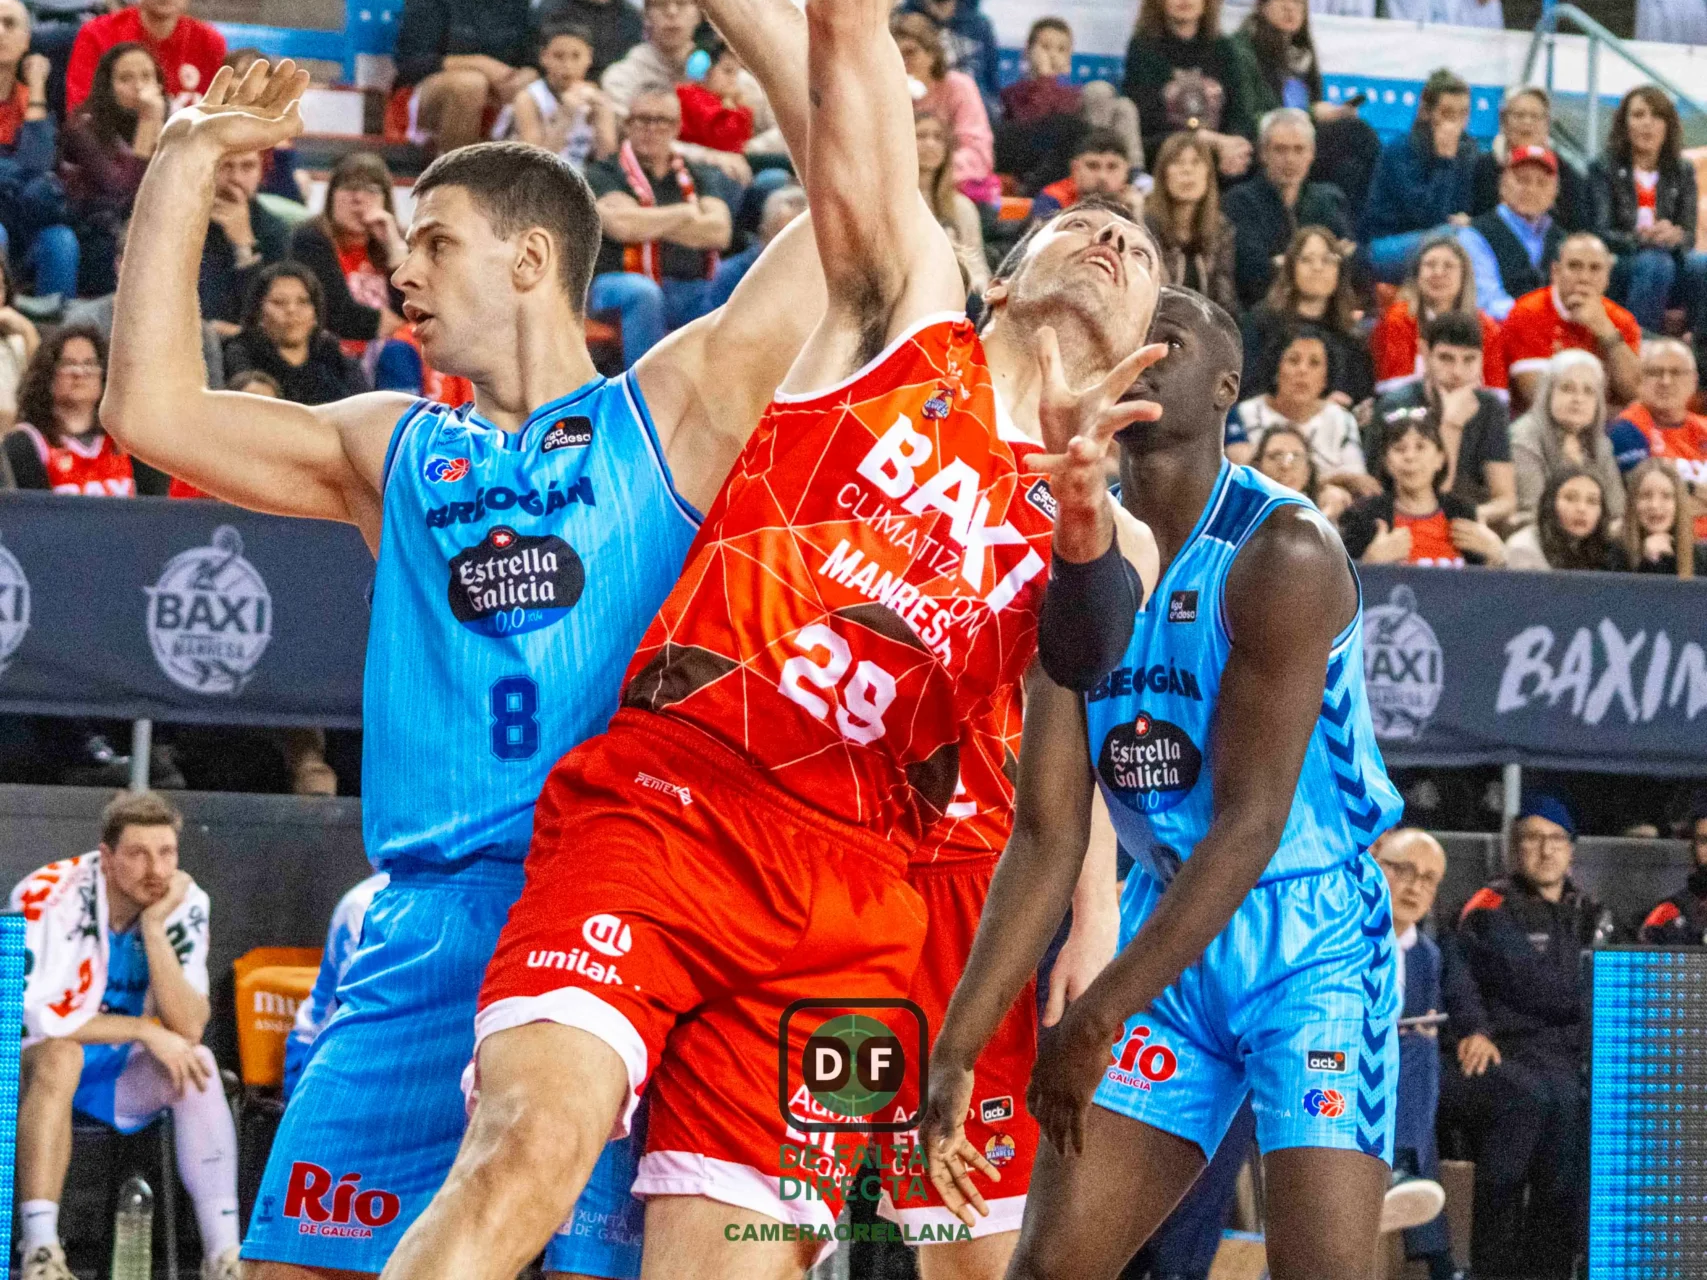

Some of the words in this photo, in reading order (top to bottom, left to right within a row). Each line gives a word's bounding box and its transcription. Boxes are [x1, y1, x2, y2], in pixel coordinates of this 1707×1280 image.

[544, 433, 591, 450] endesa
[459, 547, 559, 586] Estrella
[466, 576, 556, 613] Galicia
[156, 593, 265, 634] BAXI
[1364, 648, 1437, 684] AXI
[777, 622, 898, 747] 29
[489, 674, 541, 763] 8
[1110, 738, 1181, 764] Estrella
[1113, 762, 1180, 788] Galicia
[1309, 1054, 1338, 1070] acb
[1108, 1070, 1151, 1091] GALICIA
[984, 1107, 1005, 1120] acb
[283, 1160, 401, 1228] Río
[299, 1223, 318, 1235] DE
[321, 1225, 373, 1238] GALICIA
[578, 1209, 628, 1229] XUNTA
[574, 1223, 593, 1237] DE
[598, 1227, 643, 1245] GALIC
